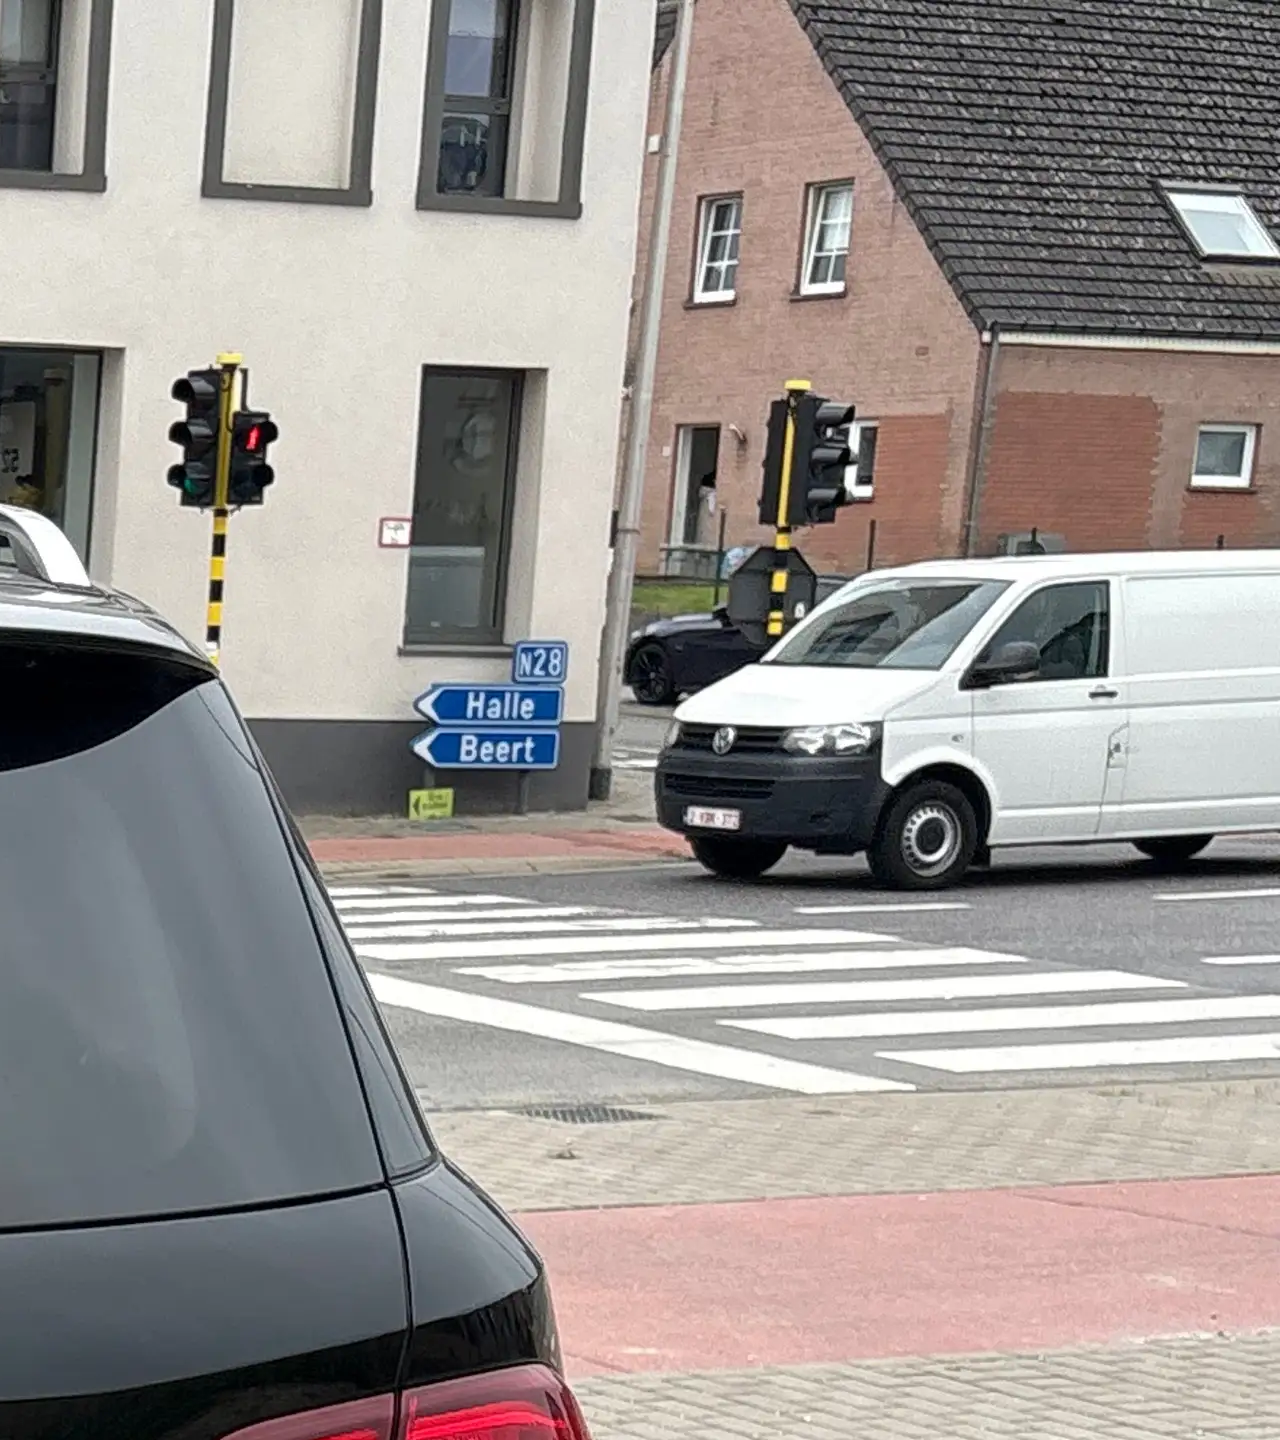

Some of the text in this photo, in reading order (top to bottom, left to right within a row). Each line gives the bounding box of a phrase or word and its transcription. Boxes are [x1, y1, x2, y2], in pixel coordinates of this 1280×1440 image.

[519, 648, 562, 677] N28
[466, 691, 535, 720] Halle
[458, 734, 536, 763] Beert
